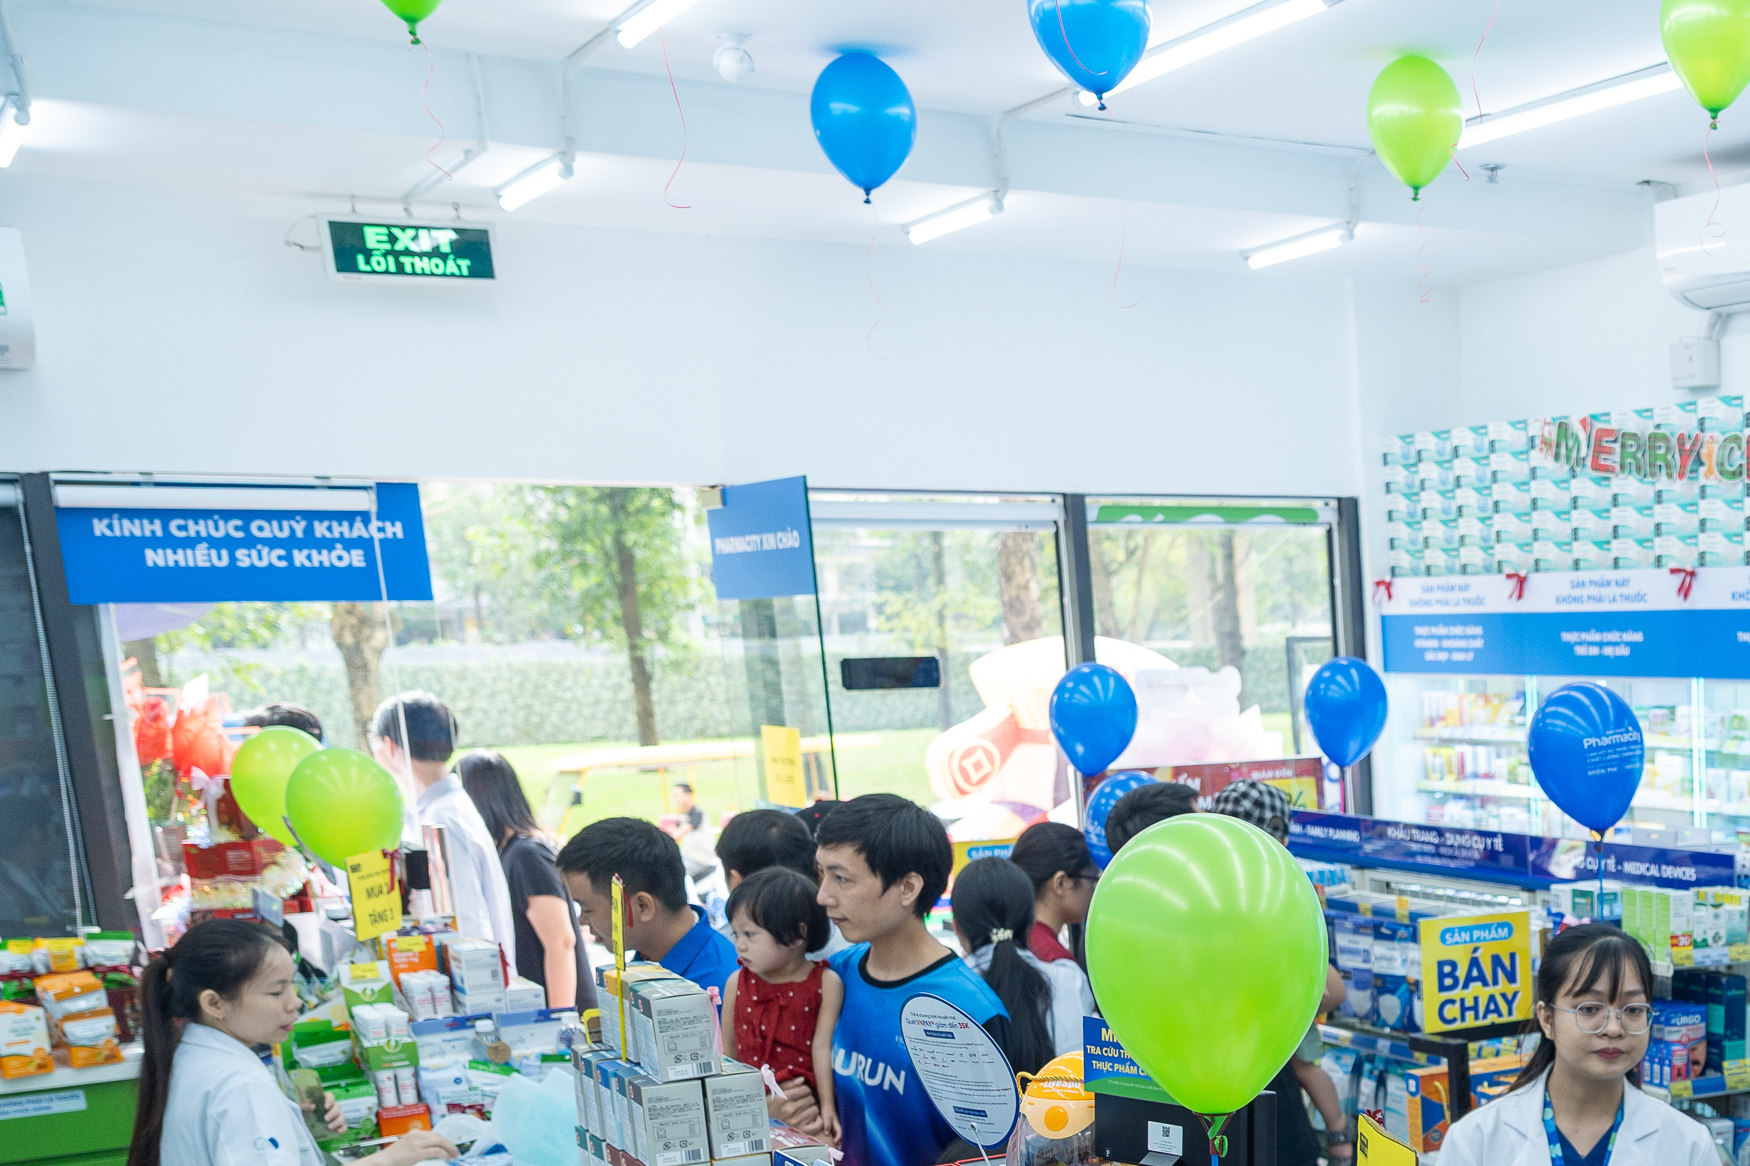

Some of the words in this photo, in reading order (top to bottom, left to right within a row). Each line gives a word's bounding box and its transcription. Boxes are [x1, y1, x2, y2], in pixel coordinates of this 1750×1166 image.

[363, 225, 459, 253] EXIT
[1553, 420, 1702, 480] MERRY
[92, 514, 162, 537] KÍNH
[169, 515, 245, 538] CHÚC
[251, 516, 307, 539] QUÝ
[314, 517, 404, 539] KHÁCH
[145, 543, 229, 568] NHIỀU
[236, 544, 288, 568] SỨC
[294, 543, 366, 568] KHỎE
[1583, 726, 1642, 750] Pharmacity
[1445, 928, 1470, 944] SẢN
[1473, 924, 1508, 941] PHẨM
[1437, 946, 1519, 994] BÁN
[1676, 1013, 1701, 1026] URGO
[1086, 1045, 1101, 1055] TRA
[1103, 1046, 1118, 1058] CỨU
[1092, 1060, 1111, 1074] THỰC
[1114, 1062, 1137, 1074] PHẨM
